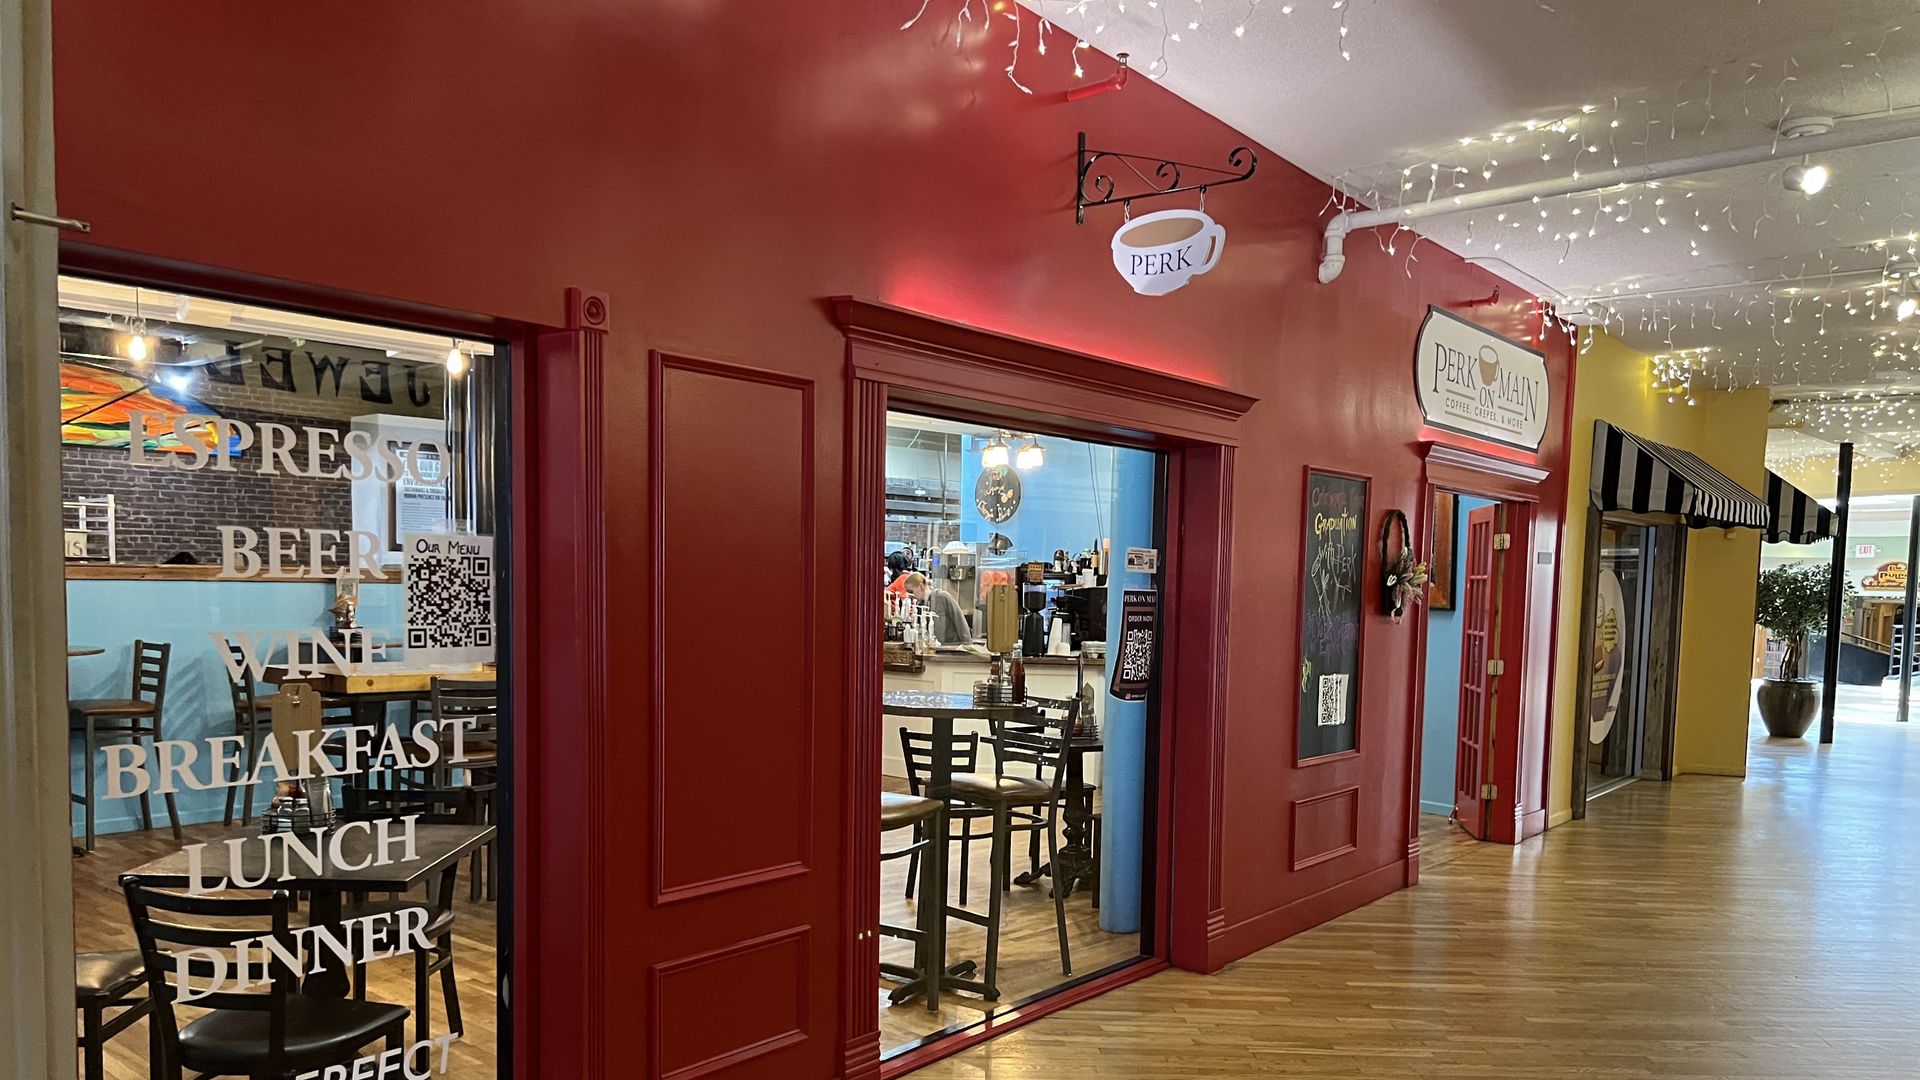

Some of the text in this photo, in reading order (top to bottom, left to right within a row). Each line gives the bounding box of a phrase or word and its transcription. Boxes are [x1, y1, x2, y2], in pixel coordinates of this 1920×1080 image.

[1130, 245, 1193, 276] PERK
[1432, 342, 1539, 424] PERK ON MAIN
[1445, 398, 1472, 414] COFFEE,
[1501, 415, 1506, 424] &
[1507, 418, 1523, 429] MORE
[124, 410, 451, 487] ESPRESSO
[217, 525, 388, 580] BEER
[448, 541, 480, 556] MENU
[1859, 546, 1872, 554] EXIT
[1124, 594, 1137, 603] PERK
[210, 627, 390, 683] WINE
[100, 716, 478, 801] BREAKFAST
[182, 814, 421, 897] LUNCH
[171, 906, 436, 1006] DINNER
